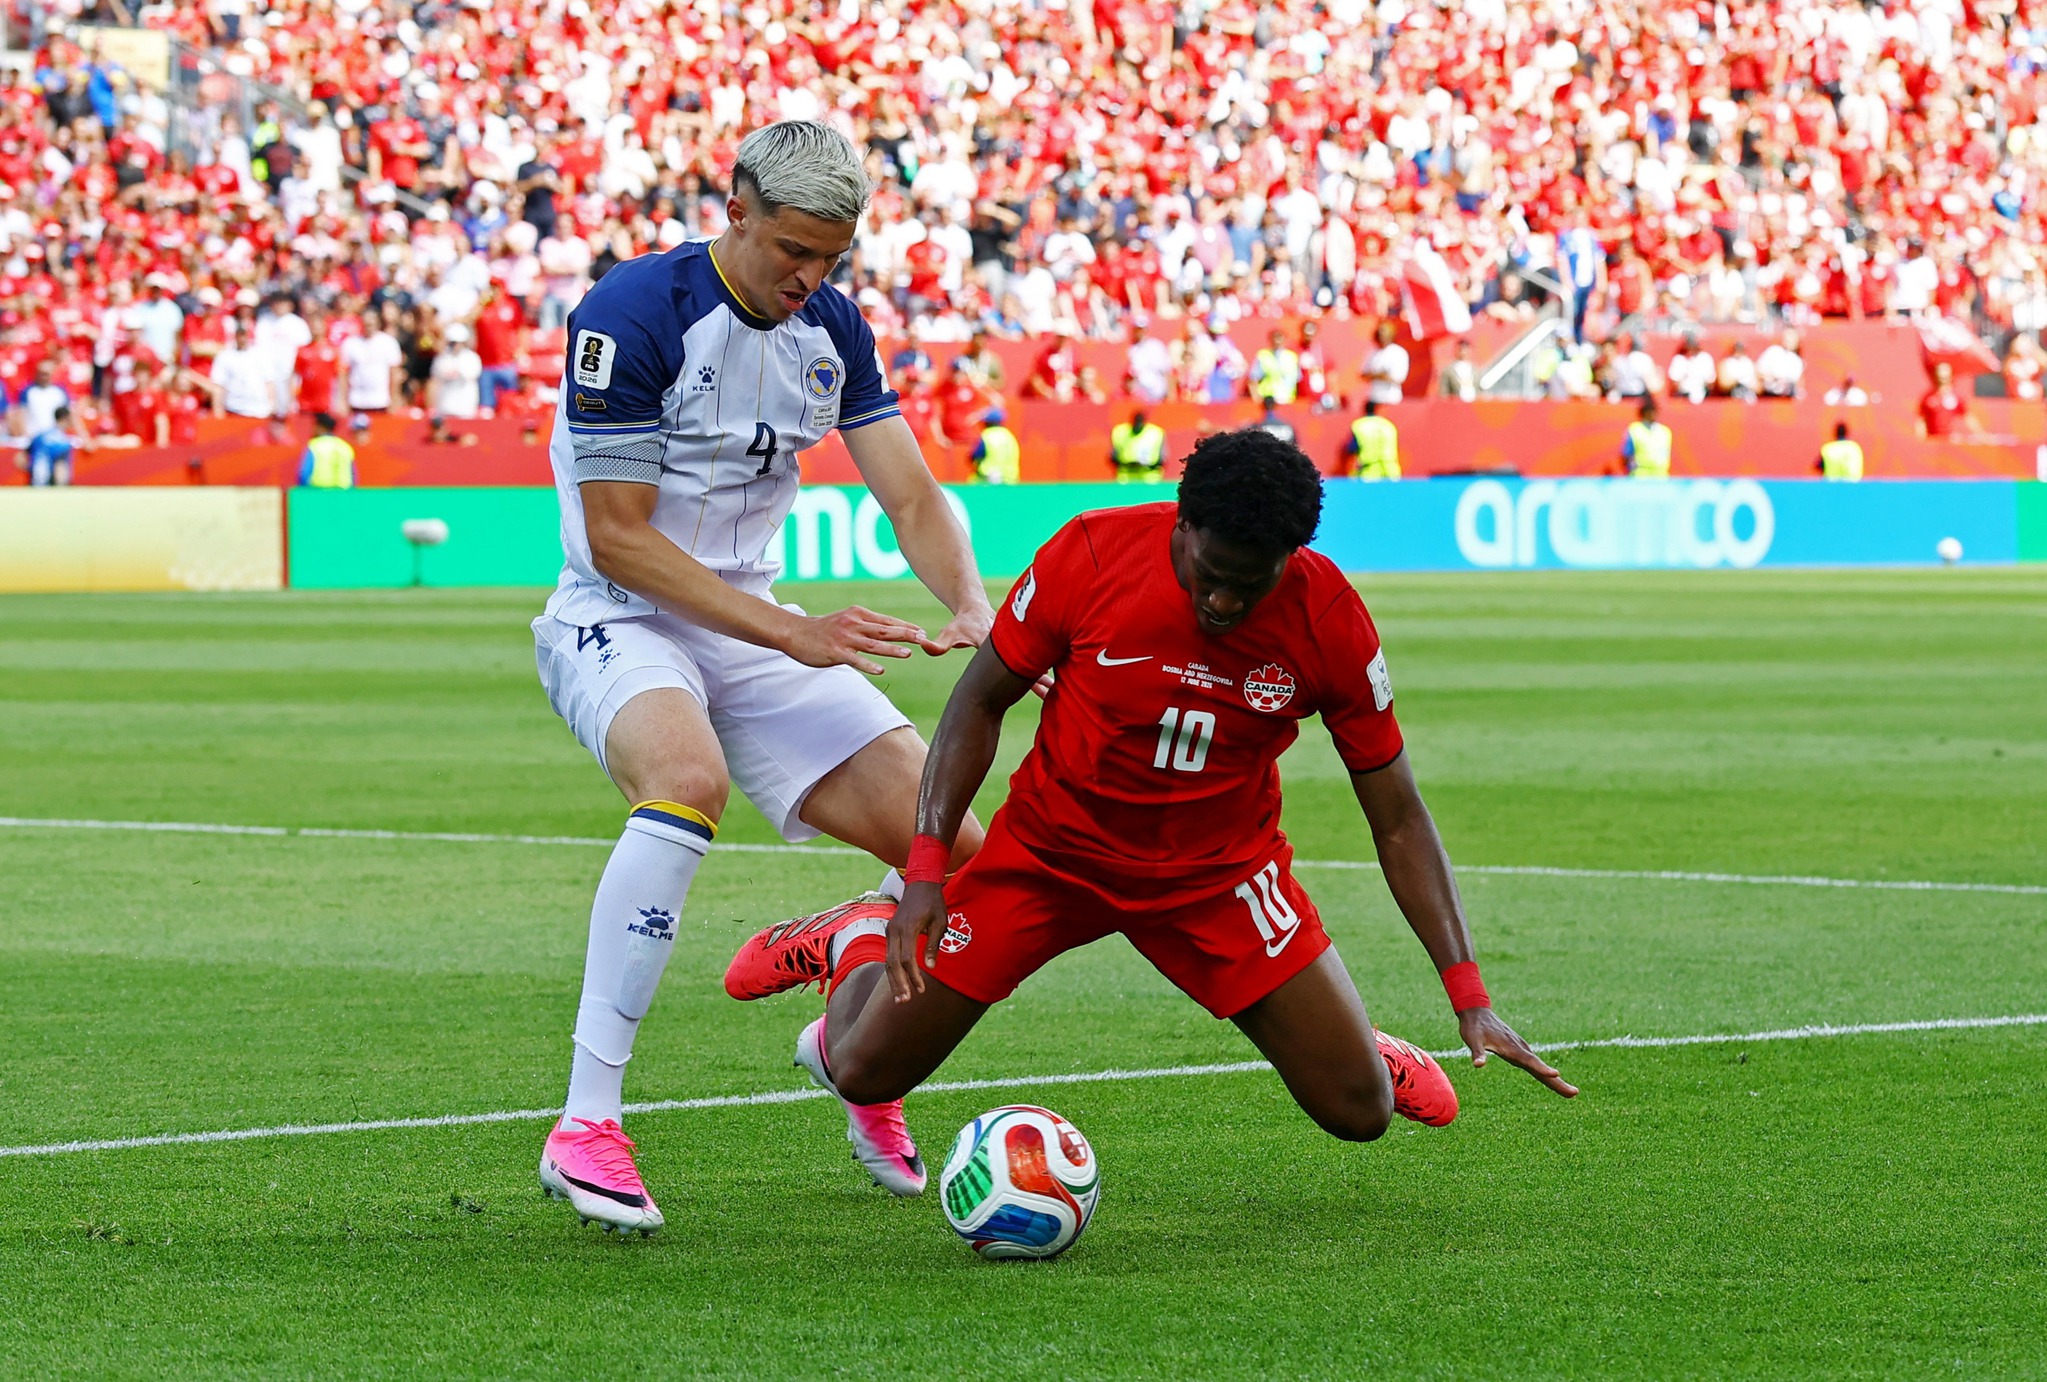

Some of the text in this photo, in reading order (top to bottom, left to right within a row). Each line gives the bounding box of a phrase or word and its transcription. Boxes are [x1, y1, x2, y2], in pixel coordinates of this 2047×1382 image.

[578, 375, 598, 384] 2026
[746, 422, 778, 476] 4
[1454, 478, 1775, 568] aramco
[577, 624, 611, 652] 4
[1246, 682, 1293, 694] CANADA
[1154, 706, 1216, 772] 10
[1234, 860, 1298, 941] 10
[626, 922, 674, 940] KELME
[946, 926, 968, 944] NADA
